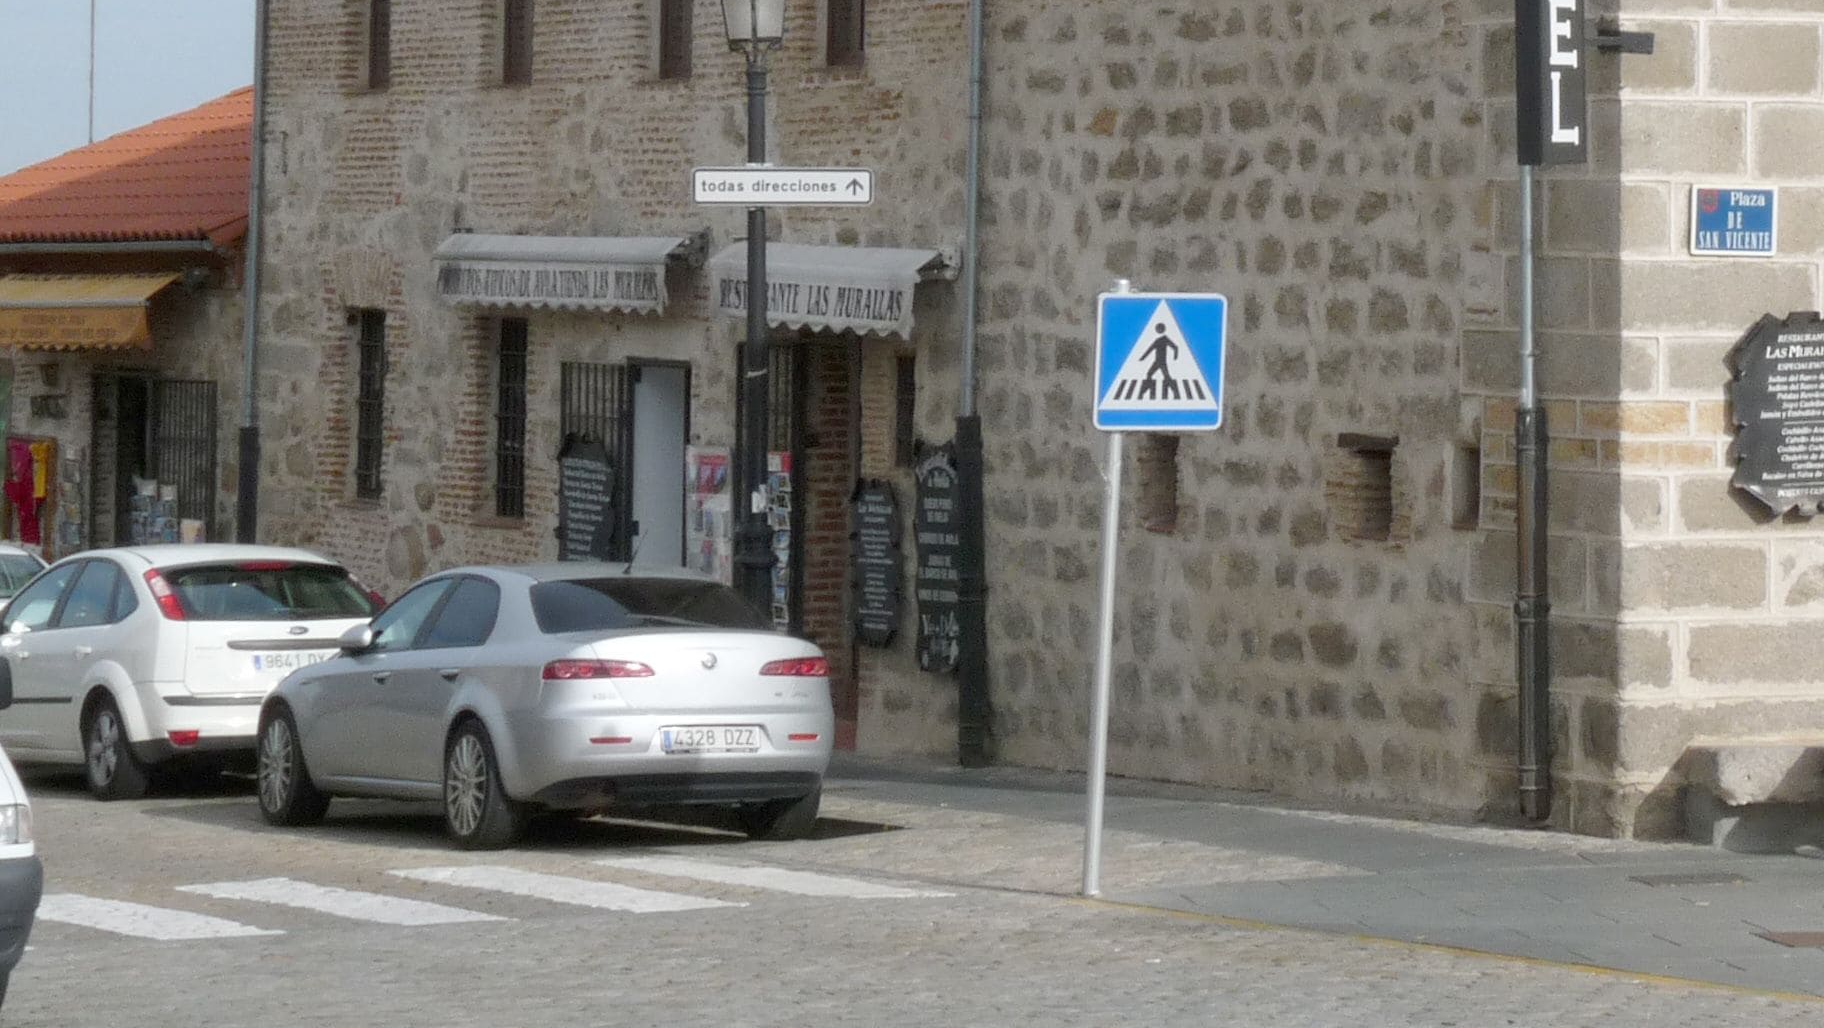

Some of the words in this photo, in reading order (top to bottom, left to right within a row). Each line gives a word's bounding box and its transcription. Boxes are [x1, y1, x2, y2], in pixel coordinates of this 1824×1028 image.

[701, 180, 745, 193] todas
[752, 179, 837, 193] direcciones
[1731, 191, 1765, 206] Plaza
[1727, 211, 1743, 229] DE
[1699, 231, 1719, 249] SAN
[1726, 231, 1770, 249] VICENTE
[719, 278, 800, 314] RESTANTE
[806, 285, 830, 316] LAS
[833, 286, 903, 321] MURALLAS
[1765, 345, 1788, 359] LAS
[265, 653, 300, 669] 9641
[674, 728, 716, 746] 4328
[724, 728, 754, 746] DZZ
